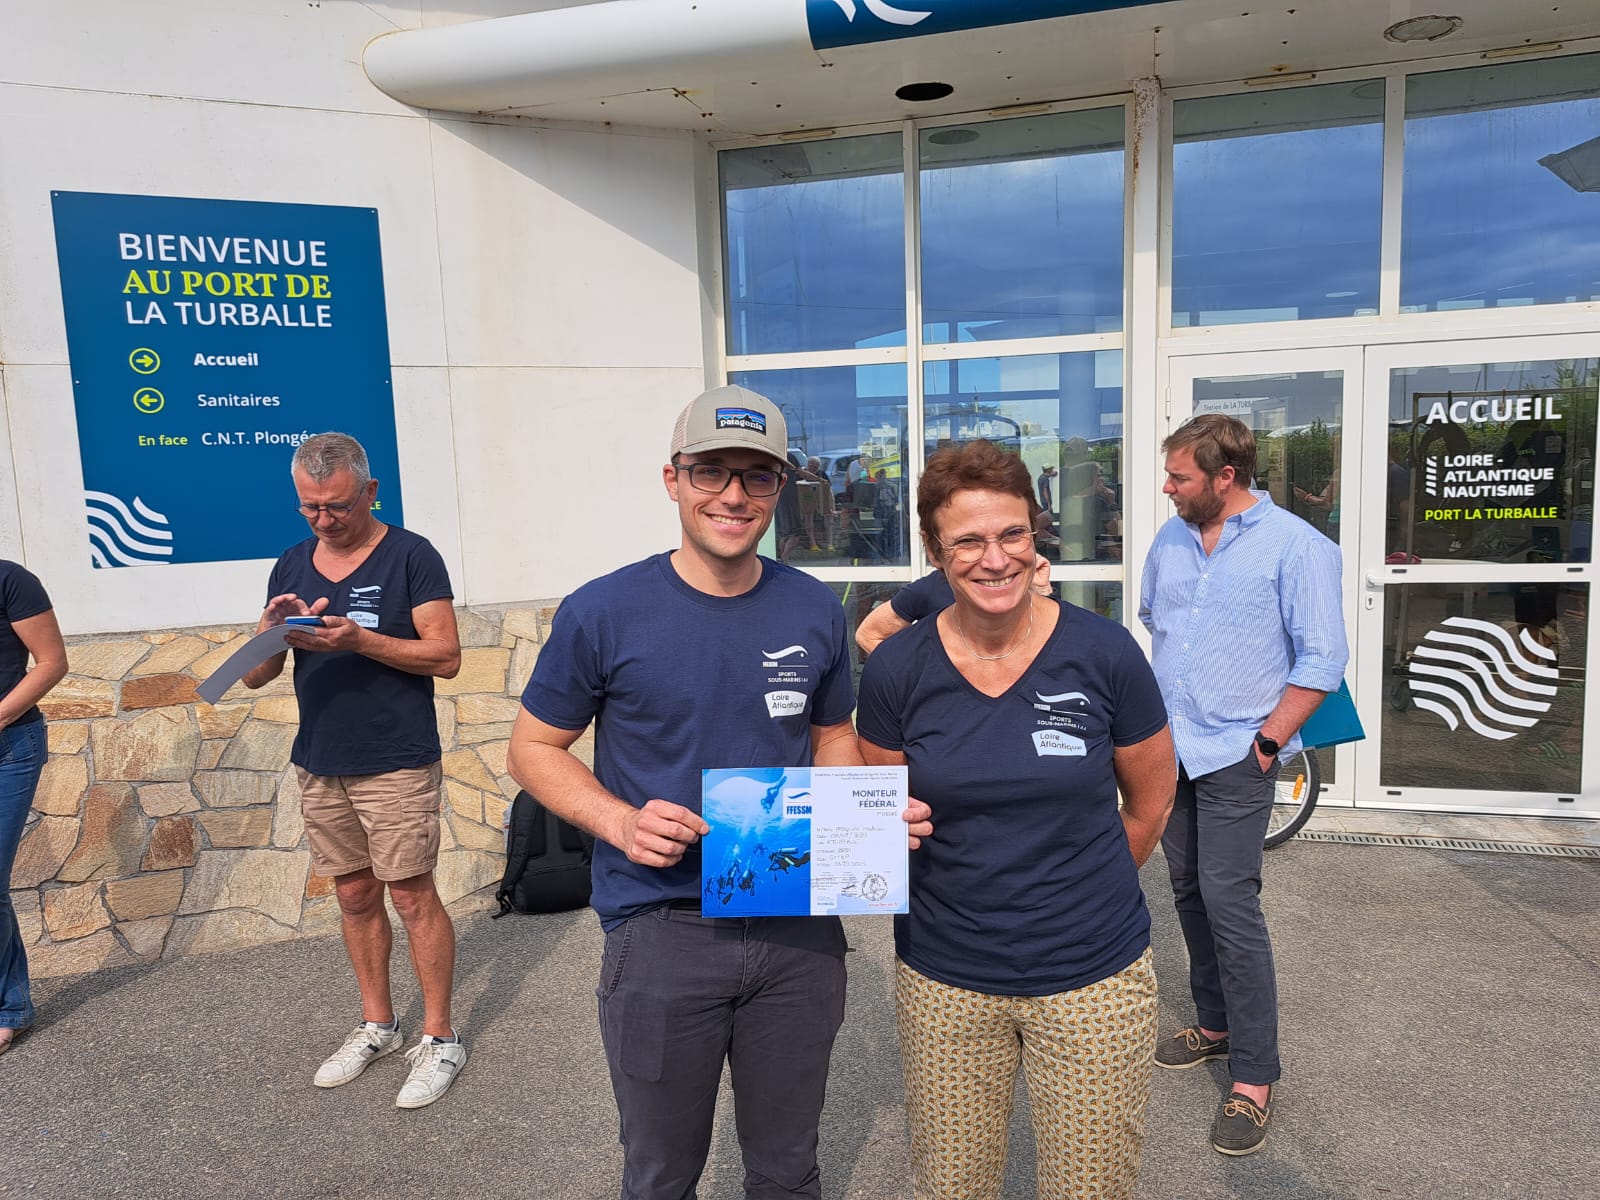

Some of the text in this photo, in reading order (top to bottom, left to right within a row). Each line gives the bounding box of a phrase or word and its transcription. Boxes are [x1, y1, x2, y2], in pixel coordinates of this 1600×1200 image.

[118, 232, 328, 267] BIENVENUE
[122, 269, 333, 299] AU PORT DE
[125, 301, 333, 328] LA TURBALLE
[194, 353, 259, 368] Accueil
[197, 393, 281, 408] Sanitaires
[1425, 397, 1562, 425] ACCUEIL
[720, 419, 763, 431] patagonia
[138, 435, 156, 447] En
[159, 434, 188, 447] face
[201, 432, 250, 447] C.N.T.
[1444, 454, 1493, 467] LOIRE
[1443, 468, 1554, 482] ATLANTIQUE
[1443, 484, 1535, 498] NAUTISME
[1425, 507, 1558, 521] PORT LA TURBALLE
[1039, 733, 1060, 741] Loire
[852, 789, 897, 798] MONITEUR
[786, 805, 813, 815] FFESSM
[859, 799, 897, 808] FÉDÉRAL
